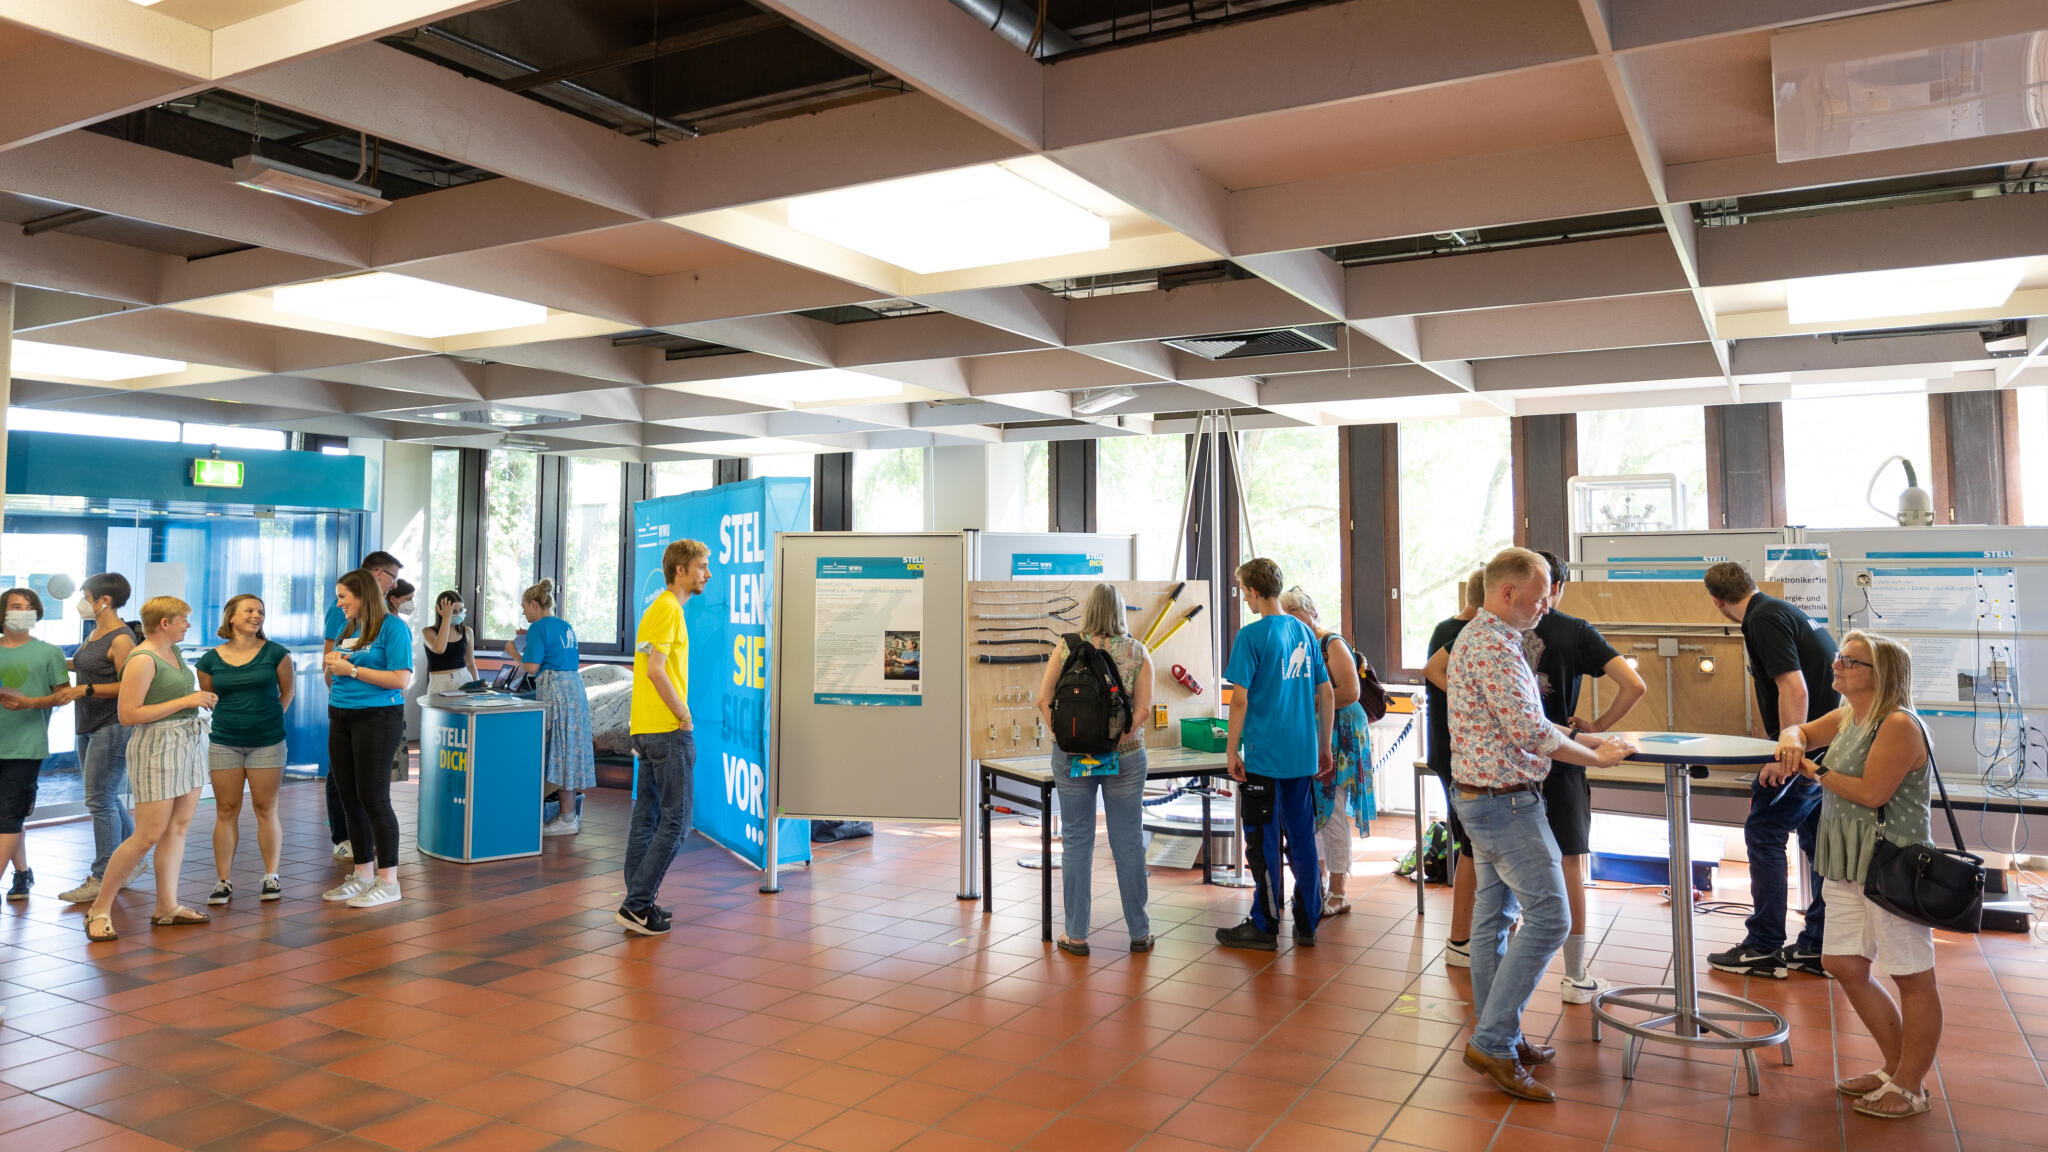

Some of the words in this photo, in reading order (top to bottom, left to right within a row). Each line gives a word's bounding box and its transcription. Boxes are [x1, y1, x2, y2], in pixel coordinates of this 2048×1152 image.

[719, 511, 765, 564] STEL
[902, 556, 925, 564] STELL
[1984, 550, 2015, 558] STELL
[907, 563, 925, 571] DICH
[730, 573, 765, 625] LEN
[1806, 594, 1821, 602] und
[734, 634, 765, 689] SIE
[721, 692, 765, 752] SICH
[434, 726, 468, 748] STELL
[440, 749, 468, 772] DICH
[722, 752, 765, 819] VOR
